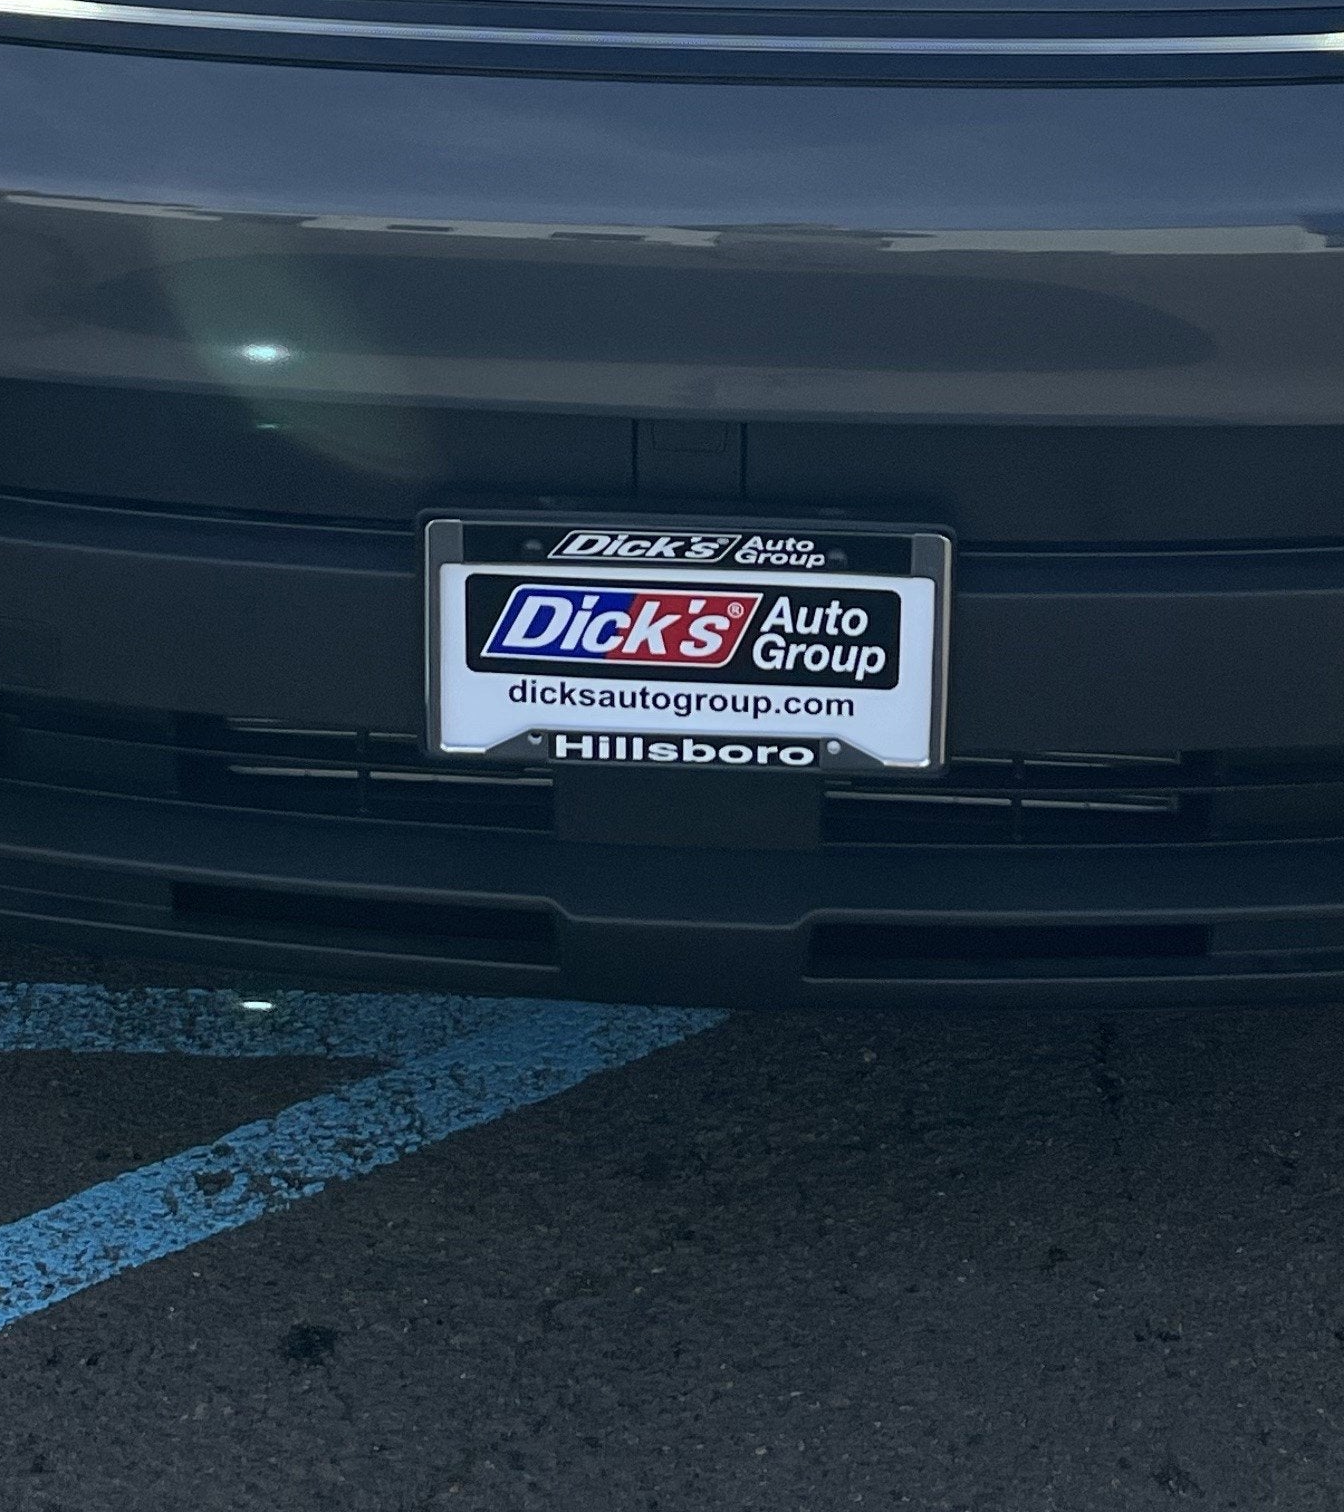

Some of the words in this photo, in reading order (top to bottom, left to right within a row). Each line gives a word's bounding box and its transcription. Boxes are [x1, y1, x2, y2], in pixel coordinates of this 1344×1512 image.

[734, 550, 826, 569] Group
[739, 536, 815, 554] Auto
[760, 596, 869, 638] Auto
[752, 637, 887, 682] Group
[508, 679, 855, 719] dicksautogroup.com
[555, 734, 816, 766] Hillsboro
